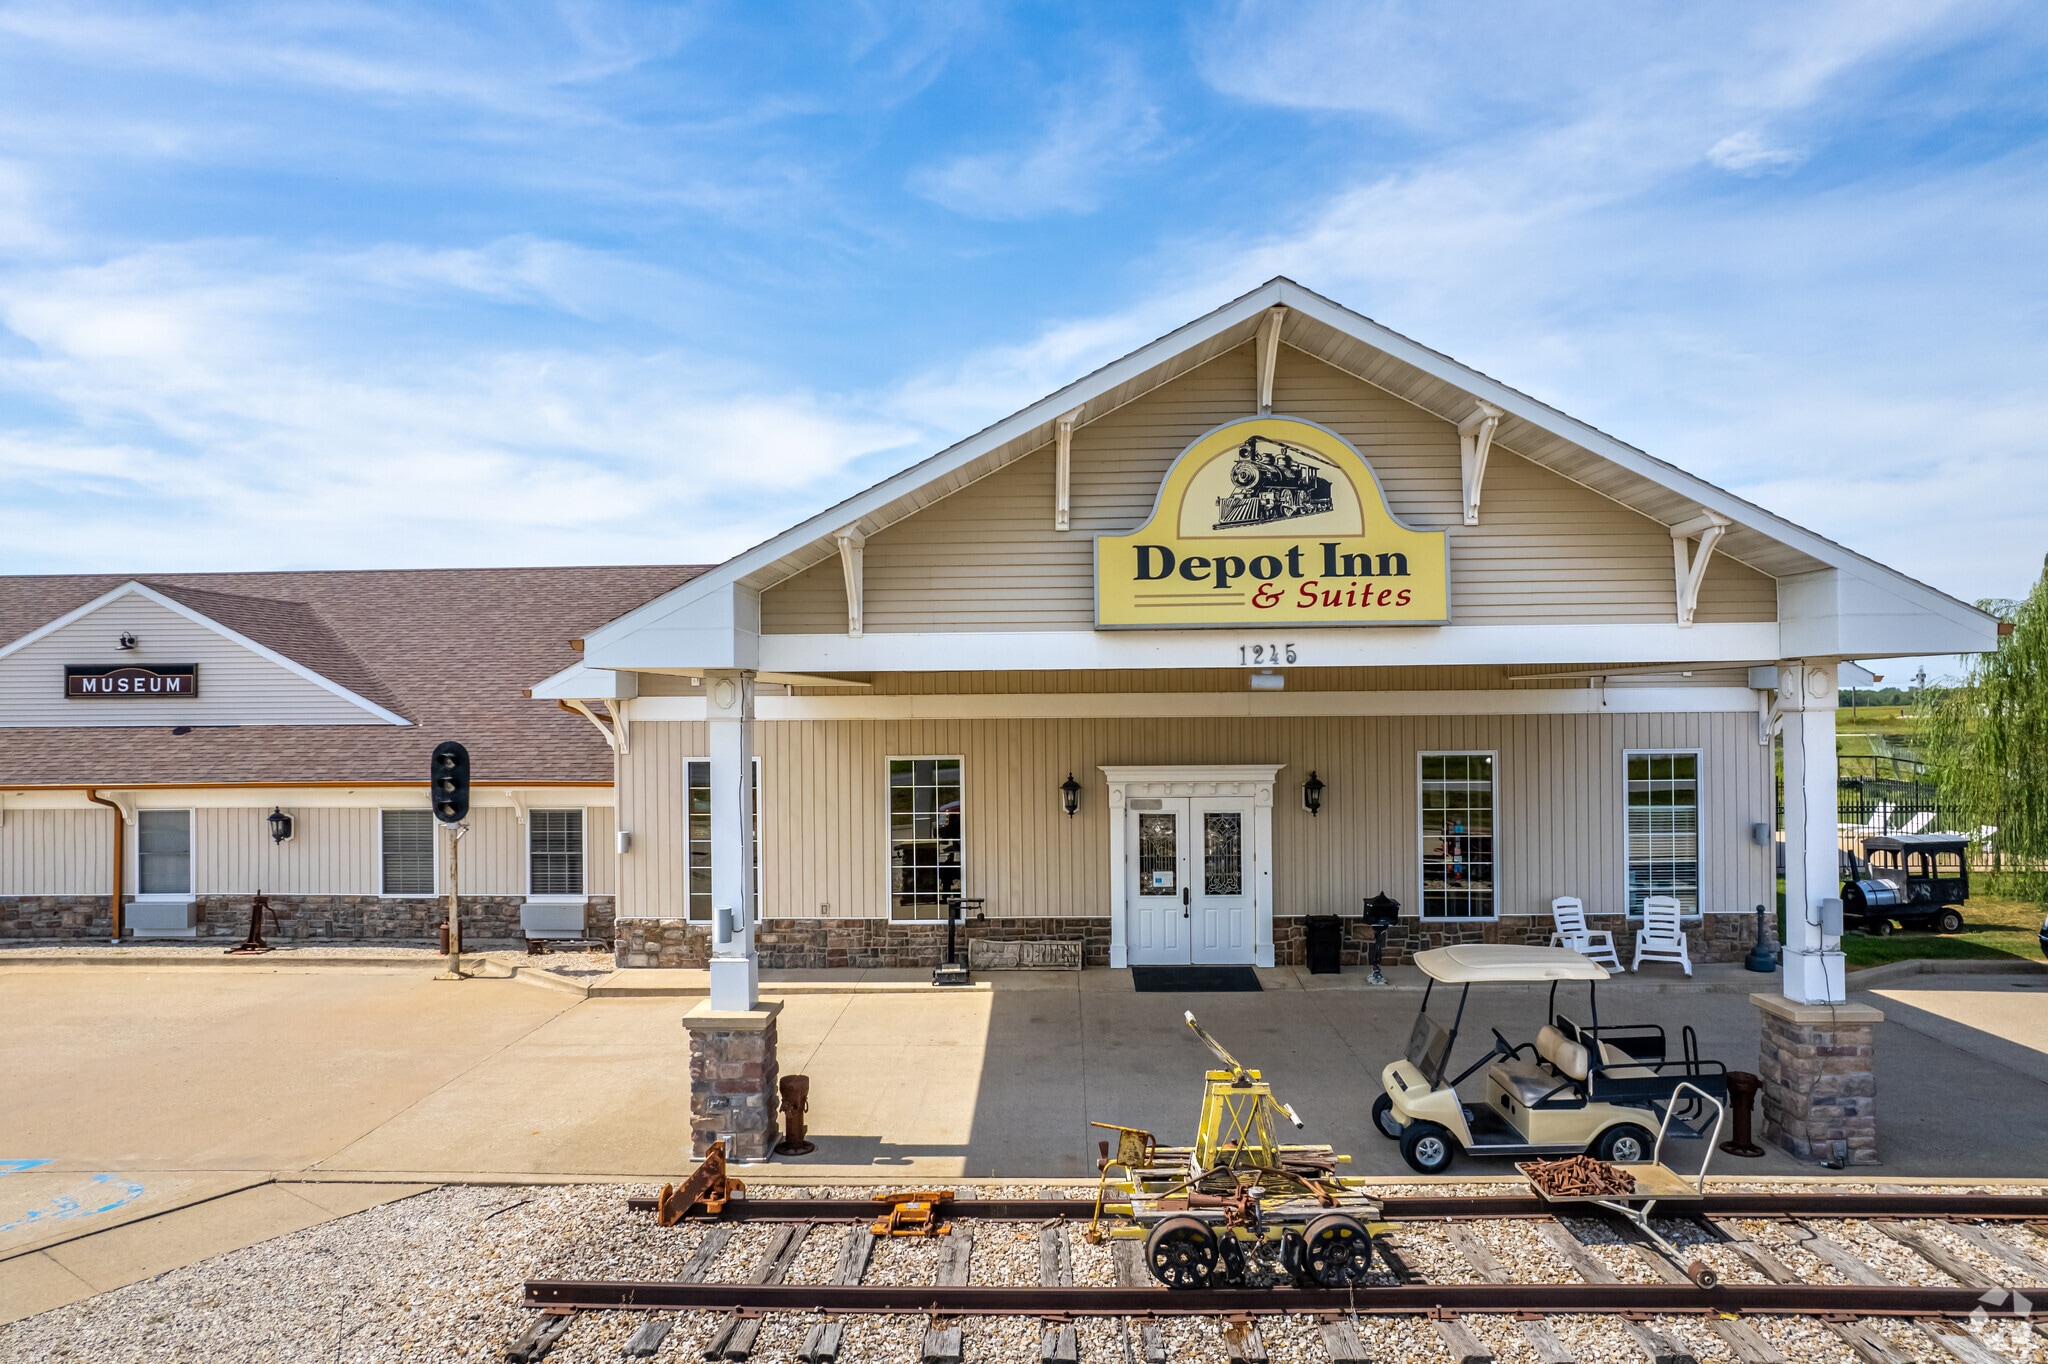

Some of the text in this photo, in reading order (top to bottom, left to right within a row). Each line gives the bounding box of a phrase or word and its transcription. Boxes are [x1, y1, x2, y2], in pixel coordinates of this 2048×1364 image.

[1132, 542, 1411, 589] Depot Inn
[1251, 580, 1412, 609] & Suites
[1240, 643, 1297, 665] 1245
[82, 677, 181, 693] MUSEUM
[1023, 943, 1057, 963] DEPOT
